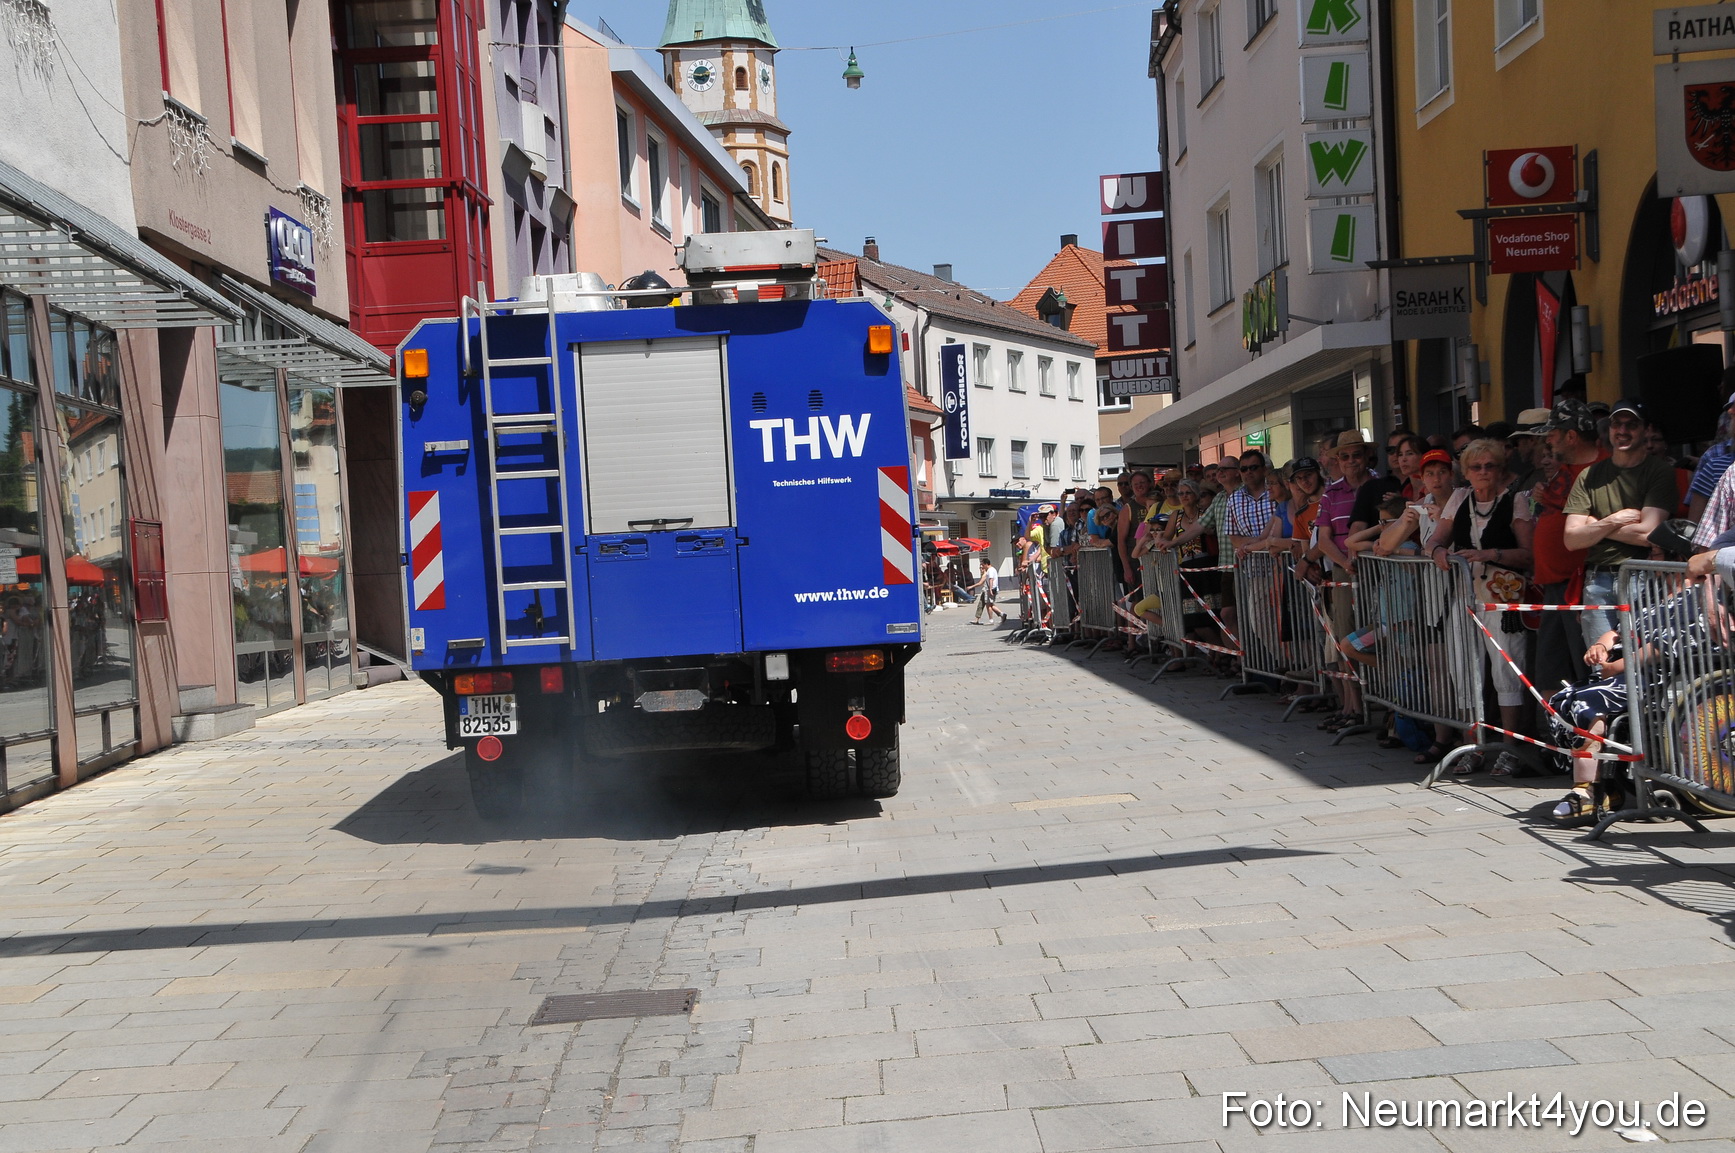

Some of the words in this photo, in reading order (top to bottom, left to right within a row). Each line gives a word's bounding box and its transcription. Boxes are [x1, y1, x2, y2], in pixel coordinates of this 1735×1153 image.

[1668, 15, 1735, 40] RATHA
[168, 208, 207, 242] Klostergasse
[207, 228, 212, 245] 2
[1495, 233, 1543, 244] Vodafone
[1544, 231, 1570, 243] Shop
[1505, 245, 1560, 257] Neumarkt
[1103, 176, 1149, 347] WITT
[1453, 286, 1466, 305] K
[1653, 274, 1719, 317] vodafone
[1396, 308, 1419, 317] MODE
[1420, 307, 1426, 315] &
[1427, 305, 1467, 315] LIFESTYLE
[1111, 357, 1169, 379] WITT
[957, 354, 966, 408] TAILOR
[1112, 378, 1171, 395] WEIDEN
[749, 413, 872, 463] THW
[960, 410, 968, 449] TOM
[772, 478, 816, 487] Technisches
[817, 476, 852, 486] Hilfswerk
[794, 586, 890, 603] www.thw.de
[471, 696, 502, 714] THW
[463, 715, 511, 734] 82535
